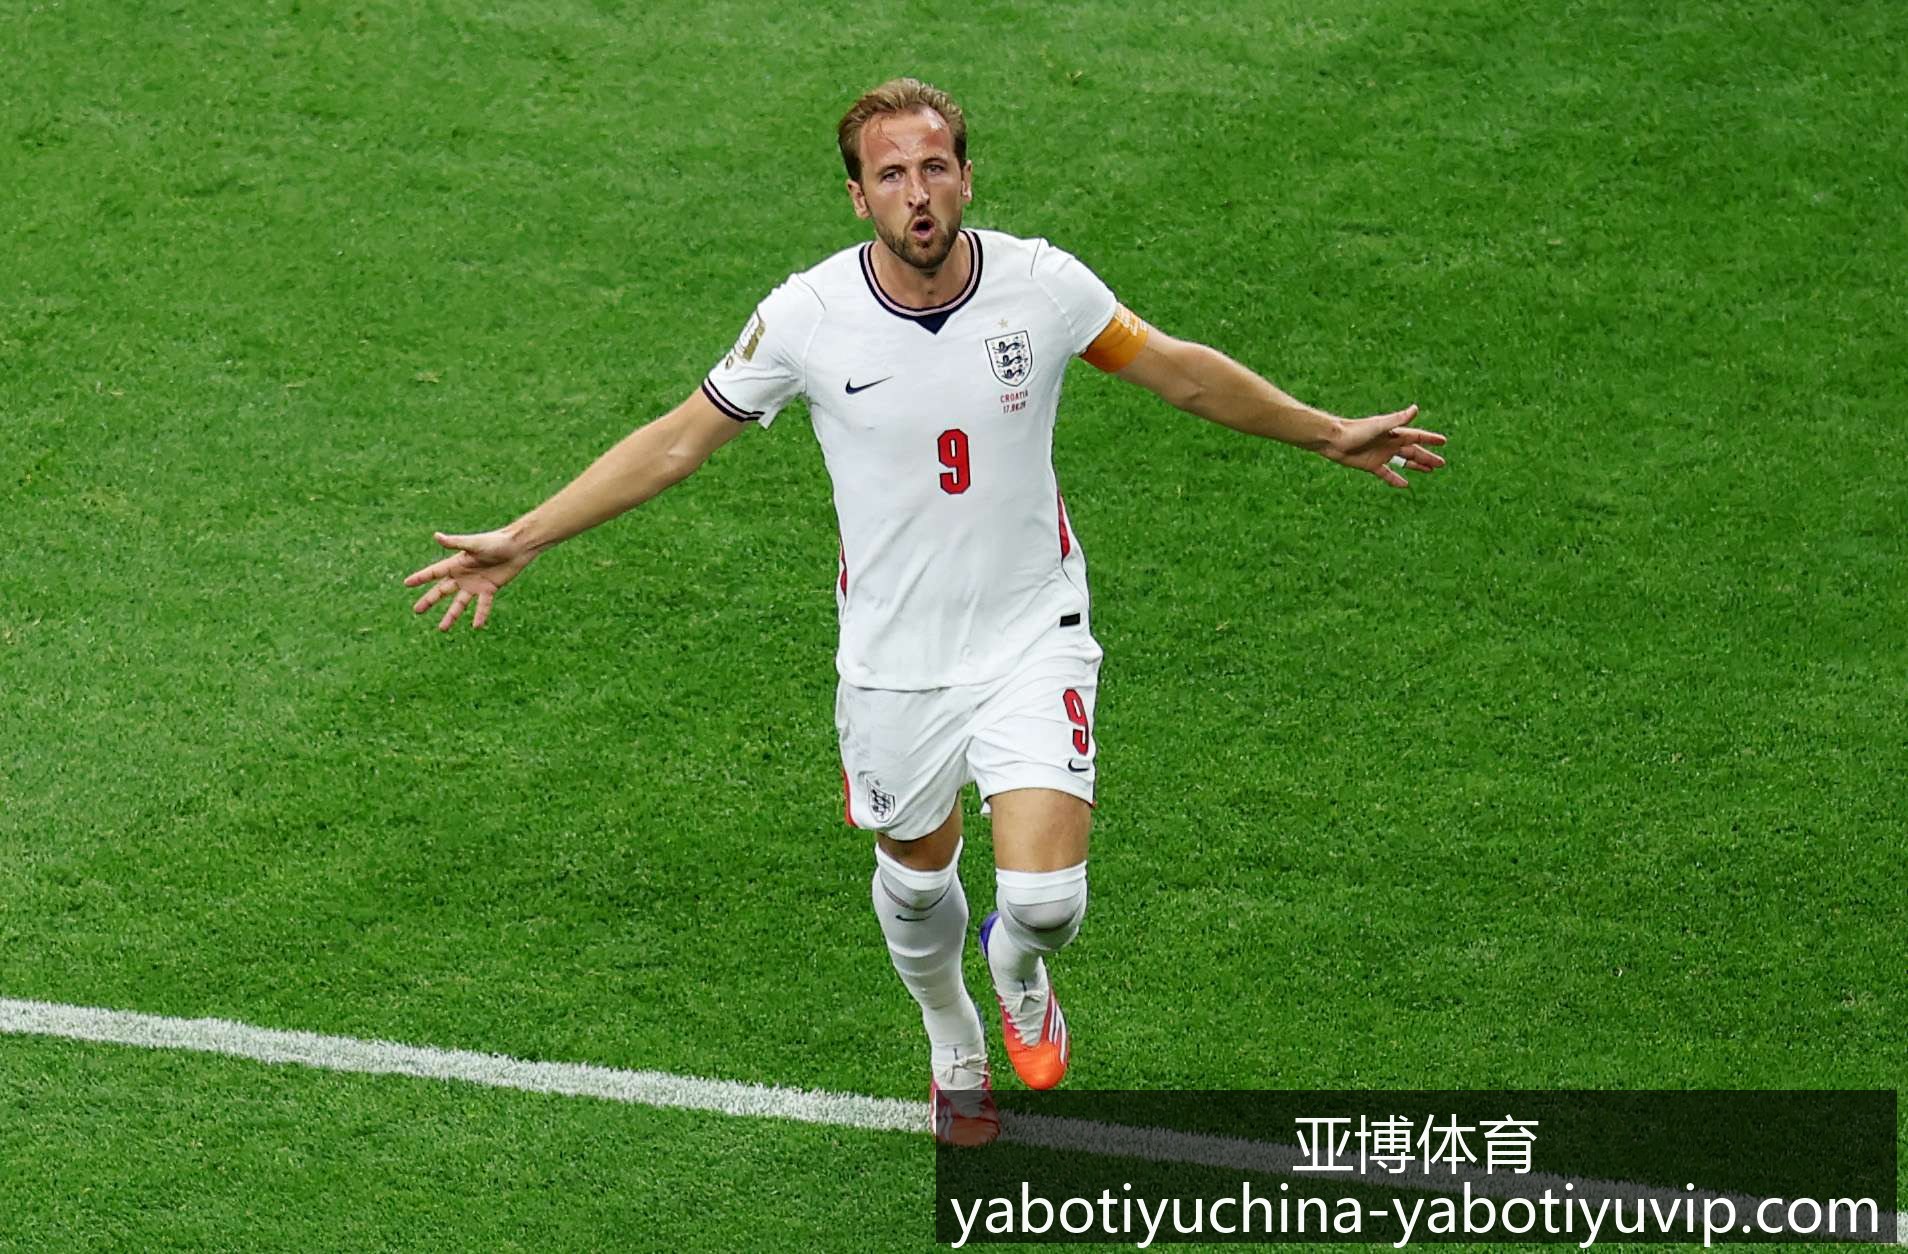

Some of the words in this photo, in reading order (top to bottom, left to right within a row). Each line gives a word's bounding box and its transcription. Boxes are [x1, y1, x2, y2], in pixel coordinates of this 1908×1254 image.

[1000, 389, 1028, 403] CROATIA
[937, 428, 971, 495] 9
[1062, 688, 1090, 756] 9
